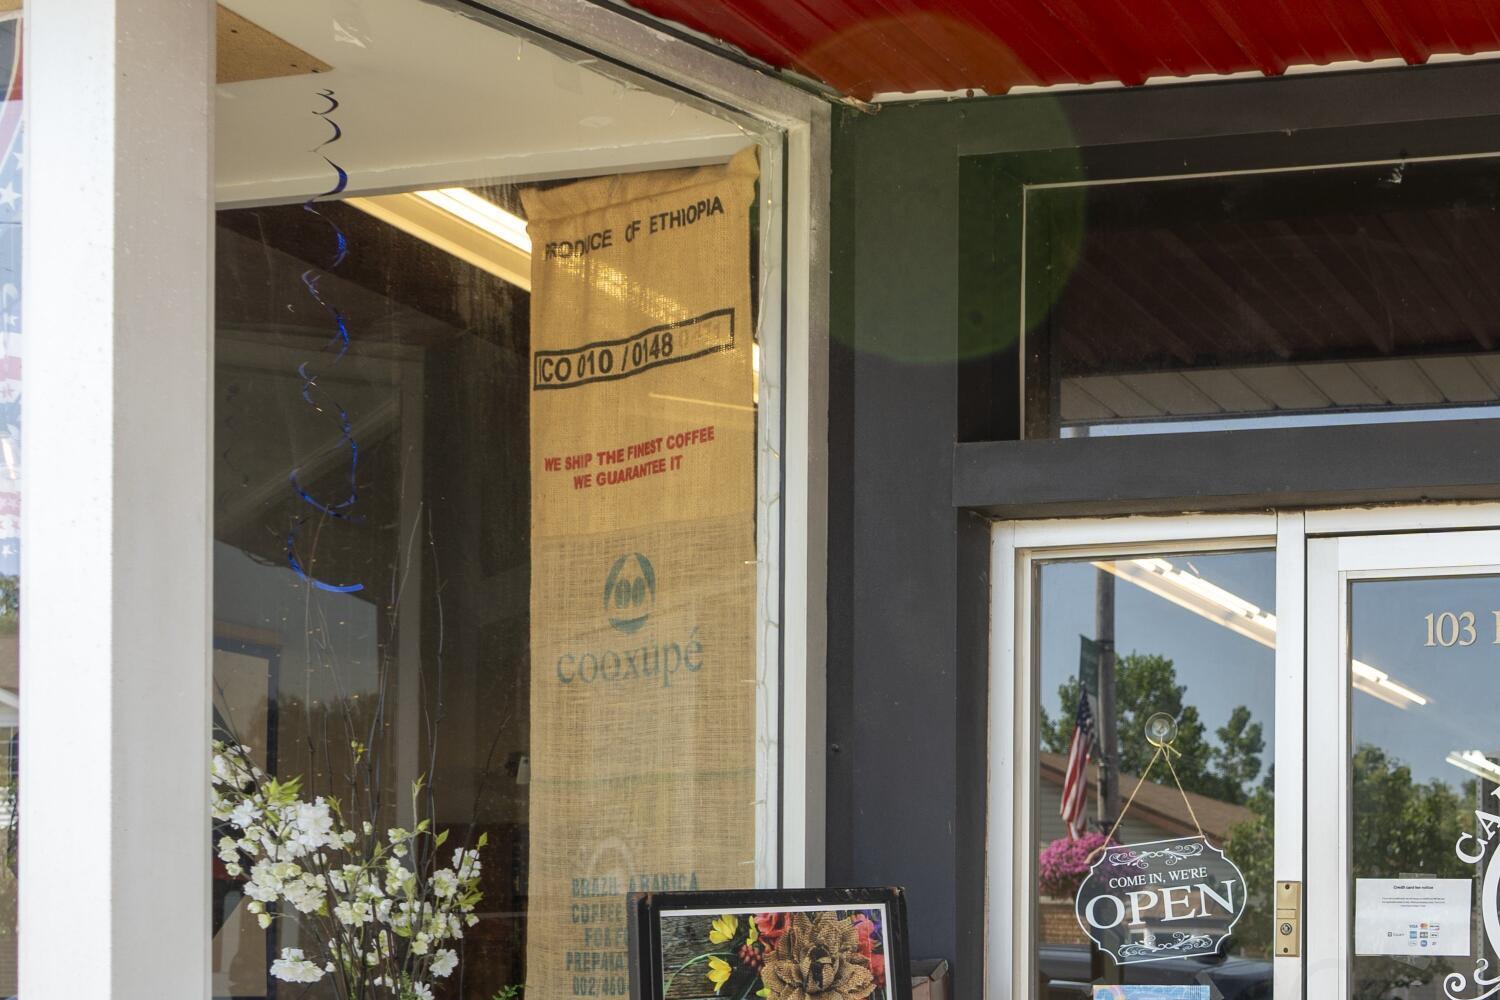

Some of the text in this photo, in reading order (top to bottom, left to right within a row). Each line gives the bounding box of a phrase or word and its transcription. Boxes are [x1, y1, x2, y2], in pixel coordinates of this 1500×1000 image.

[625, 220, 641, 243] OF
[649, 196, 724, 234] ETHIOPIA
[538, 357, 572, 382] ICO
[577, 348, 613, 378] 010
[544, 426, 715, 472] WE SHIP THE FINEST COFFEE
[573, 455, 683, 489] WE GUARANTEE IT
[1423, 611, 1478, 647] 103
[1109, 867, 1208, 889] COME IN, WE'RE
[1085, 879, 1237, 929] OPEN
[566, 951, 628, 972] PREPARA
